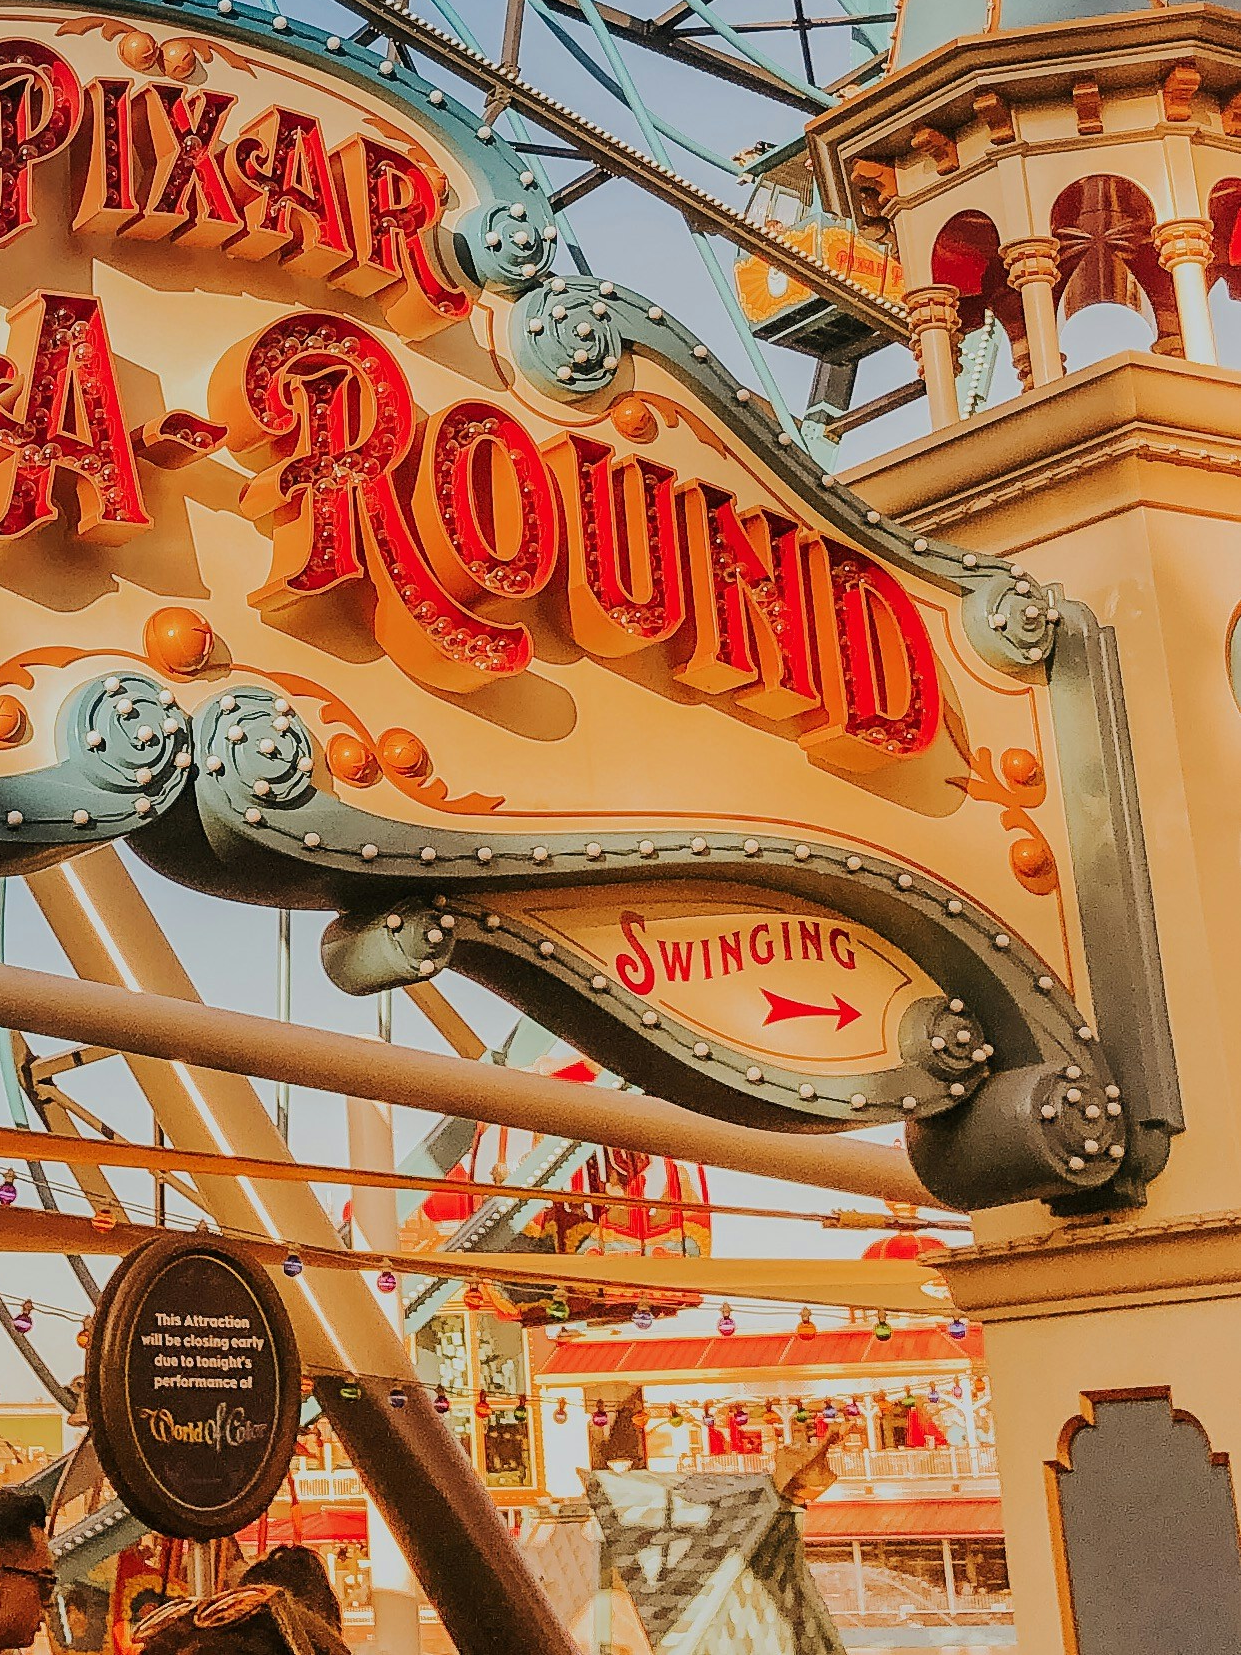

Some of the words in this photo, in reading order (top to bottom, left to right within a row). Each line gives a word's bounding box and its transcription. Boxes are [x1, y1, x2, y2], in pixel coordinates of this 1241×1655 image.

[615, 910, 858, 996] SWINGING
[155, 1313, 182, 1327] This
[184, 1314, 251, 1329] Attraction
[141, 1333, 163, 1346] will
[165, 1333, 182, 1347] be
[183, 1334, 230, 1351] closing
[230, 1335, 265, 1352] early
[154, 1353, 179, 1367] due
[180, 1355, 195, 1368] to
[196, 1355, 253, 1371] tonight's
[154, 1375, 238, 1390] performance
[239, 1375, 253, 1389] of
[138, 1408, 204, 1443] World
